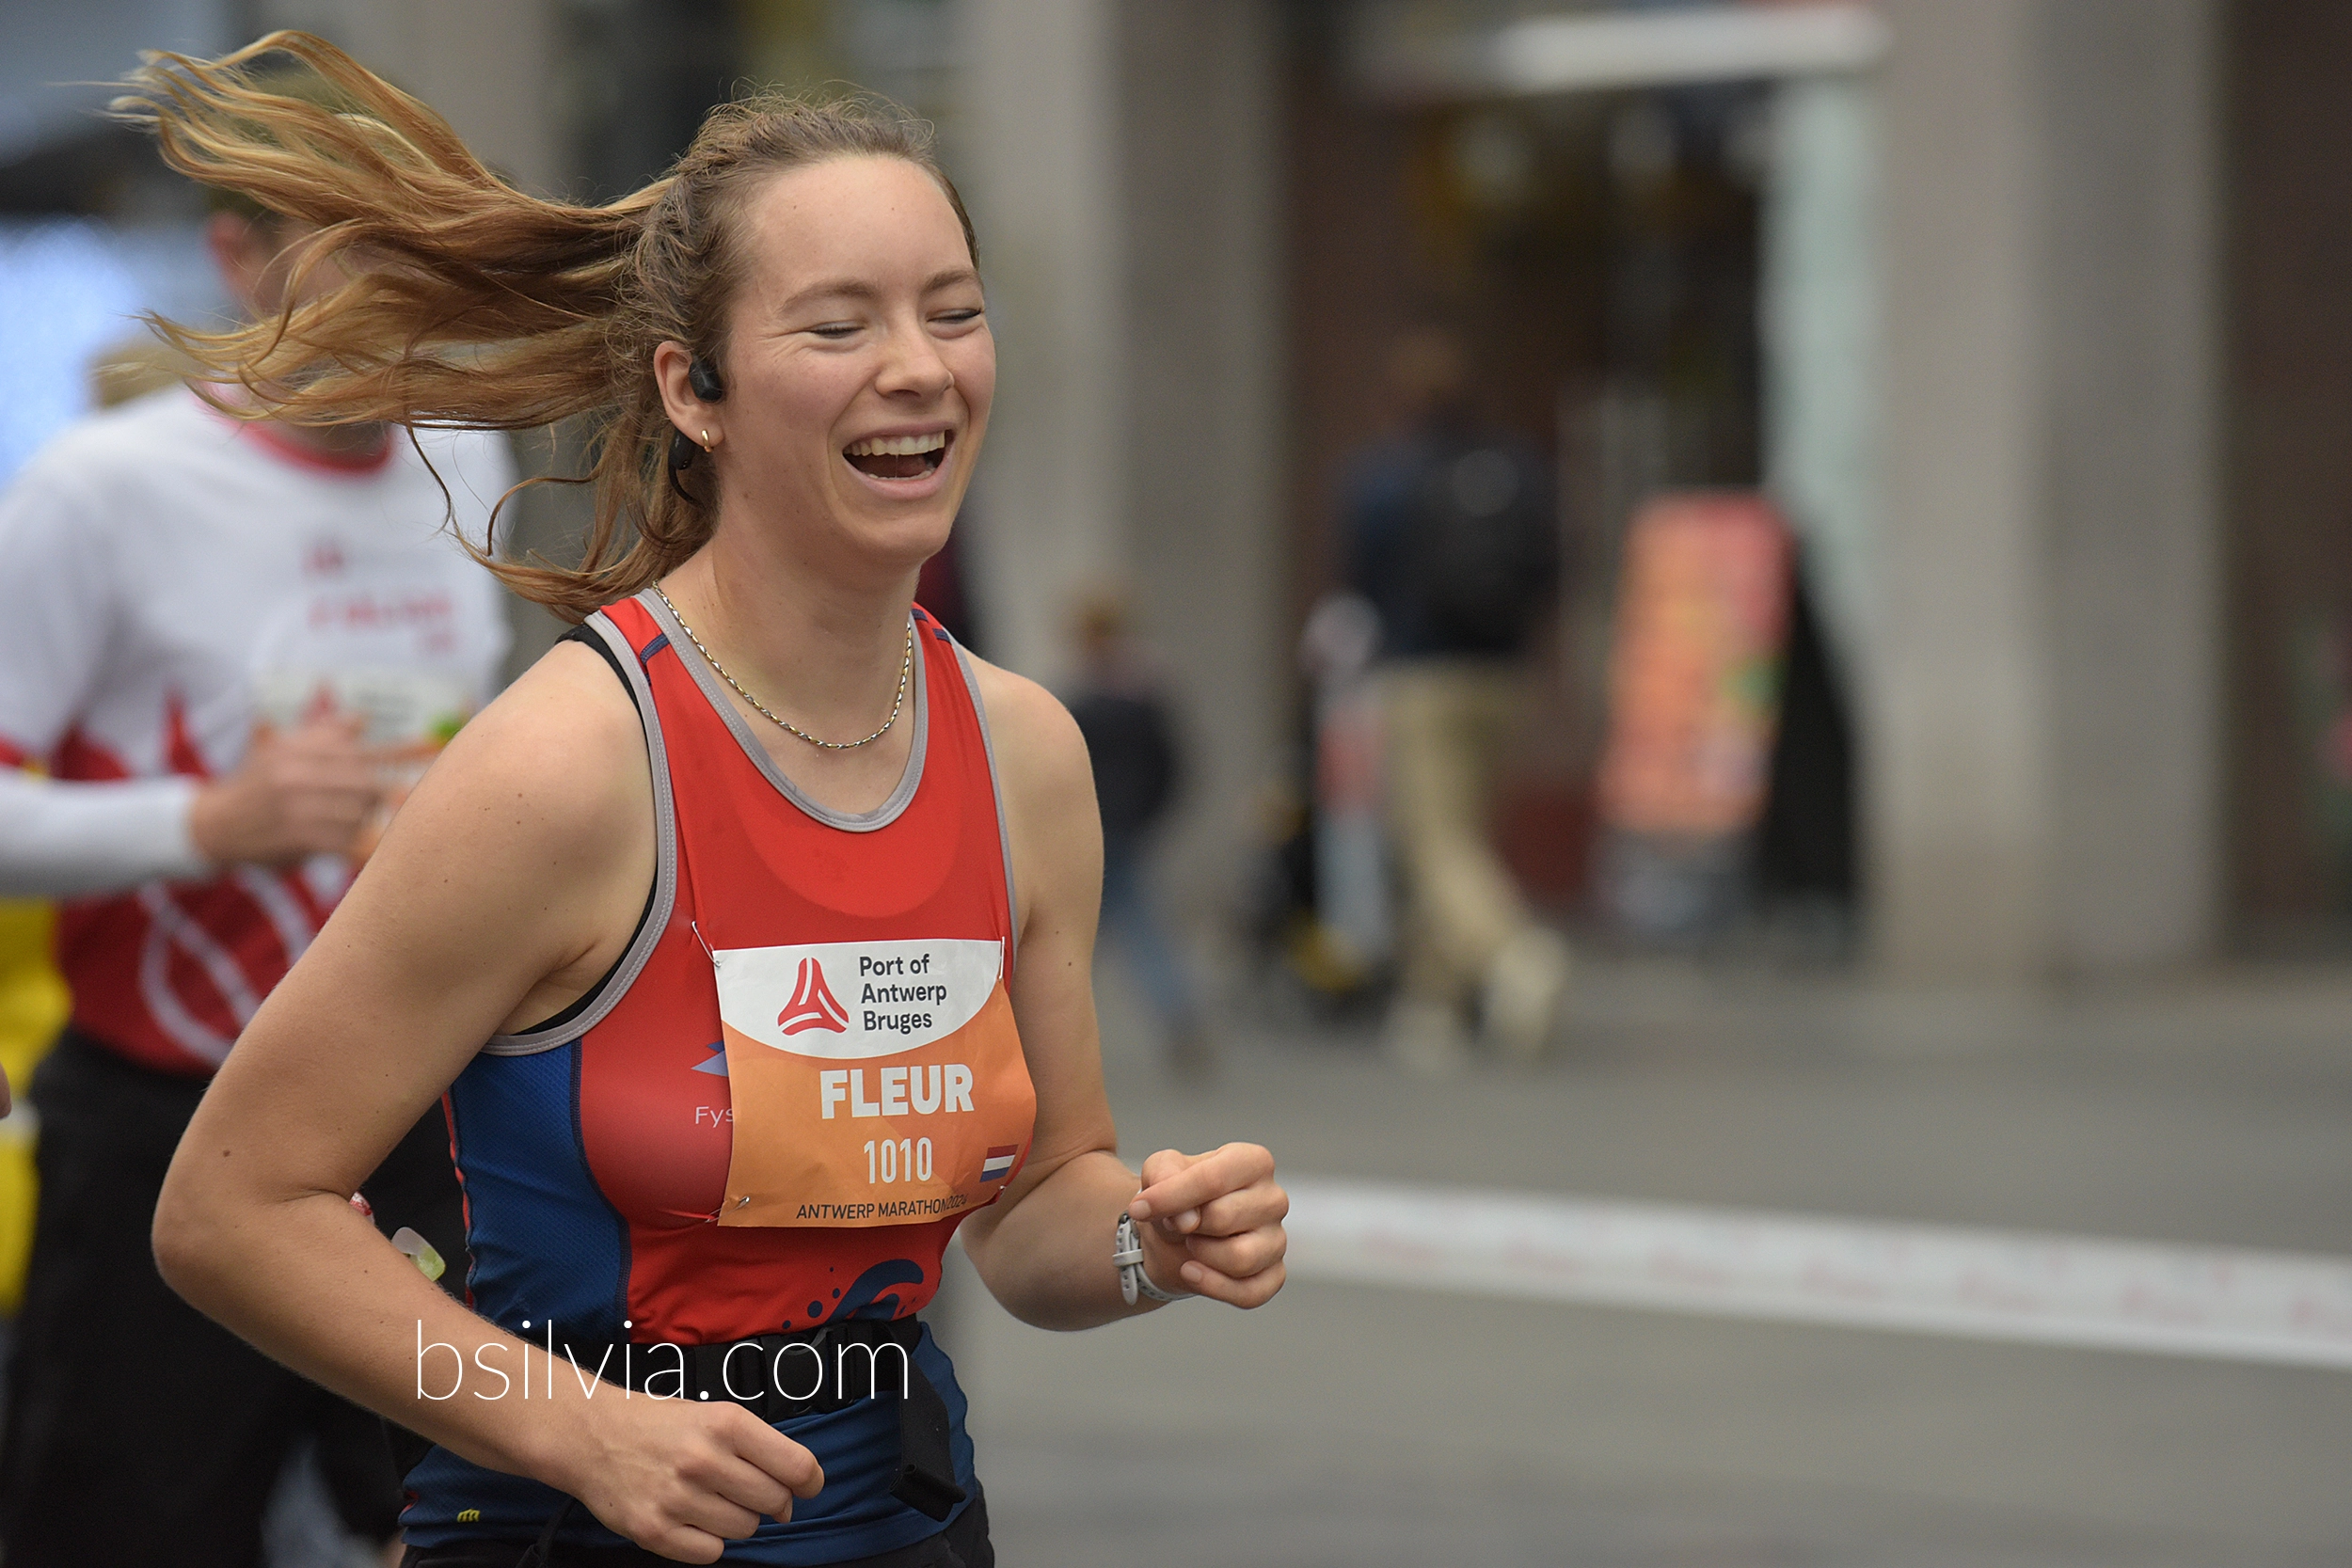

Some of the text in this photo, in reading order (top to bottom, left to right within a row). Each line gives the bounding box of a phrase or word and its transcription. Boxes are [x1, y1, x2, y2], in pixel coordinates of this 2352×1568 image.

[859, 954, 930, 977] Port of
[860, 981, 947, 1006] Antwerp
[863, 1009, 932, 1035] Bruges
[819, 1063, 975, 1120] FLEUR
[863, 1137, 932, 1185] 1010
[796, 1203, 876, 1220] ANTWERP
[878, 1197, 946, 1217] MARATHON
